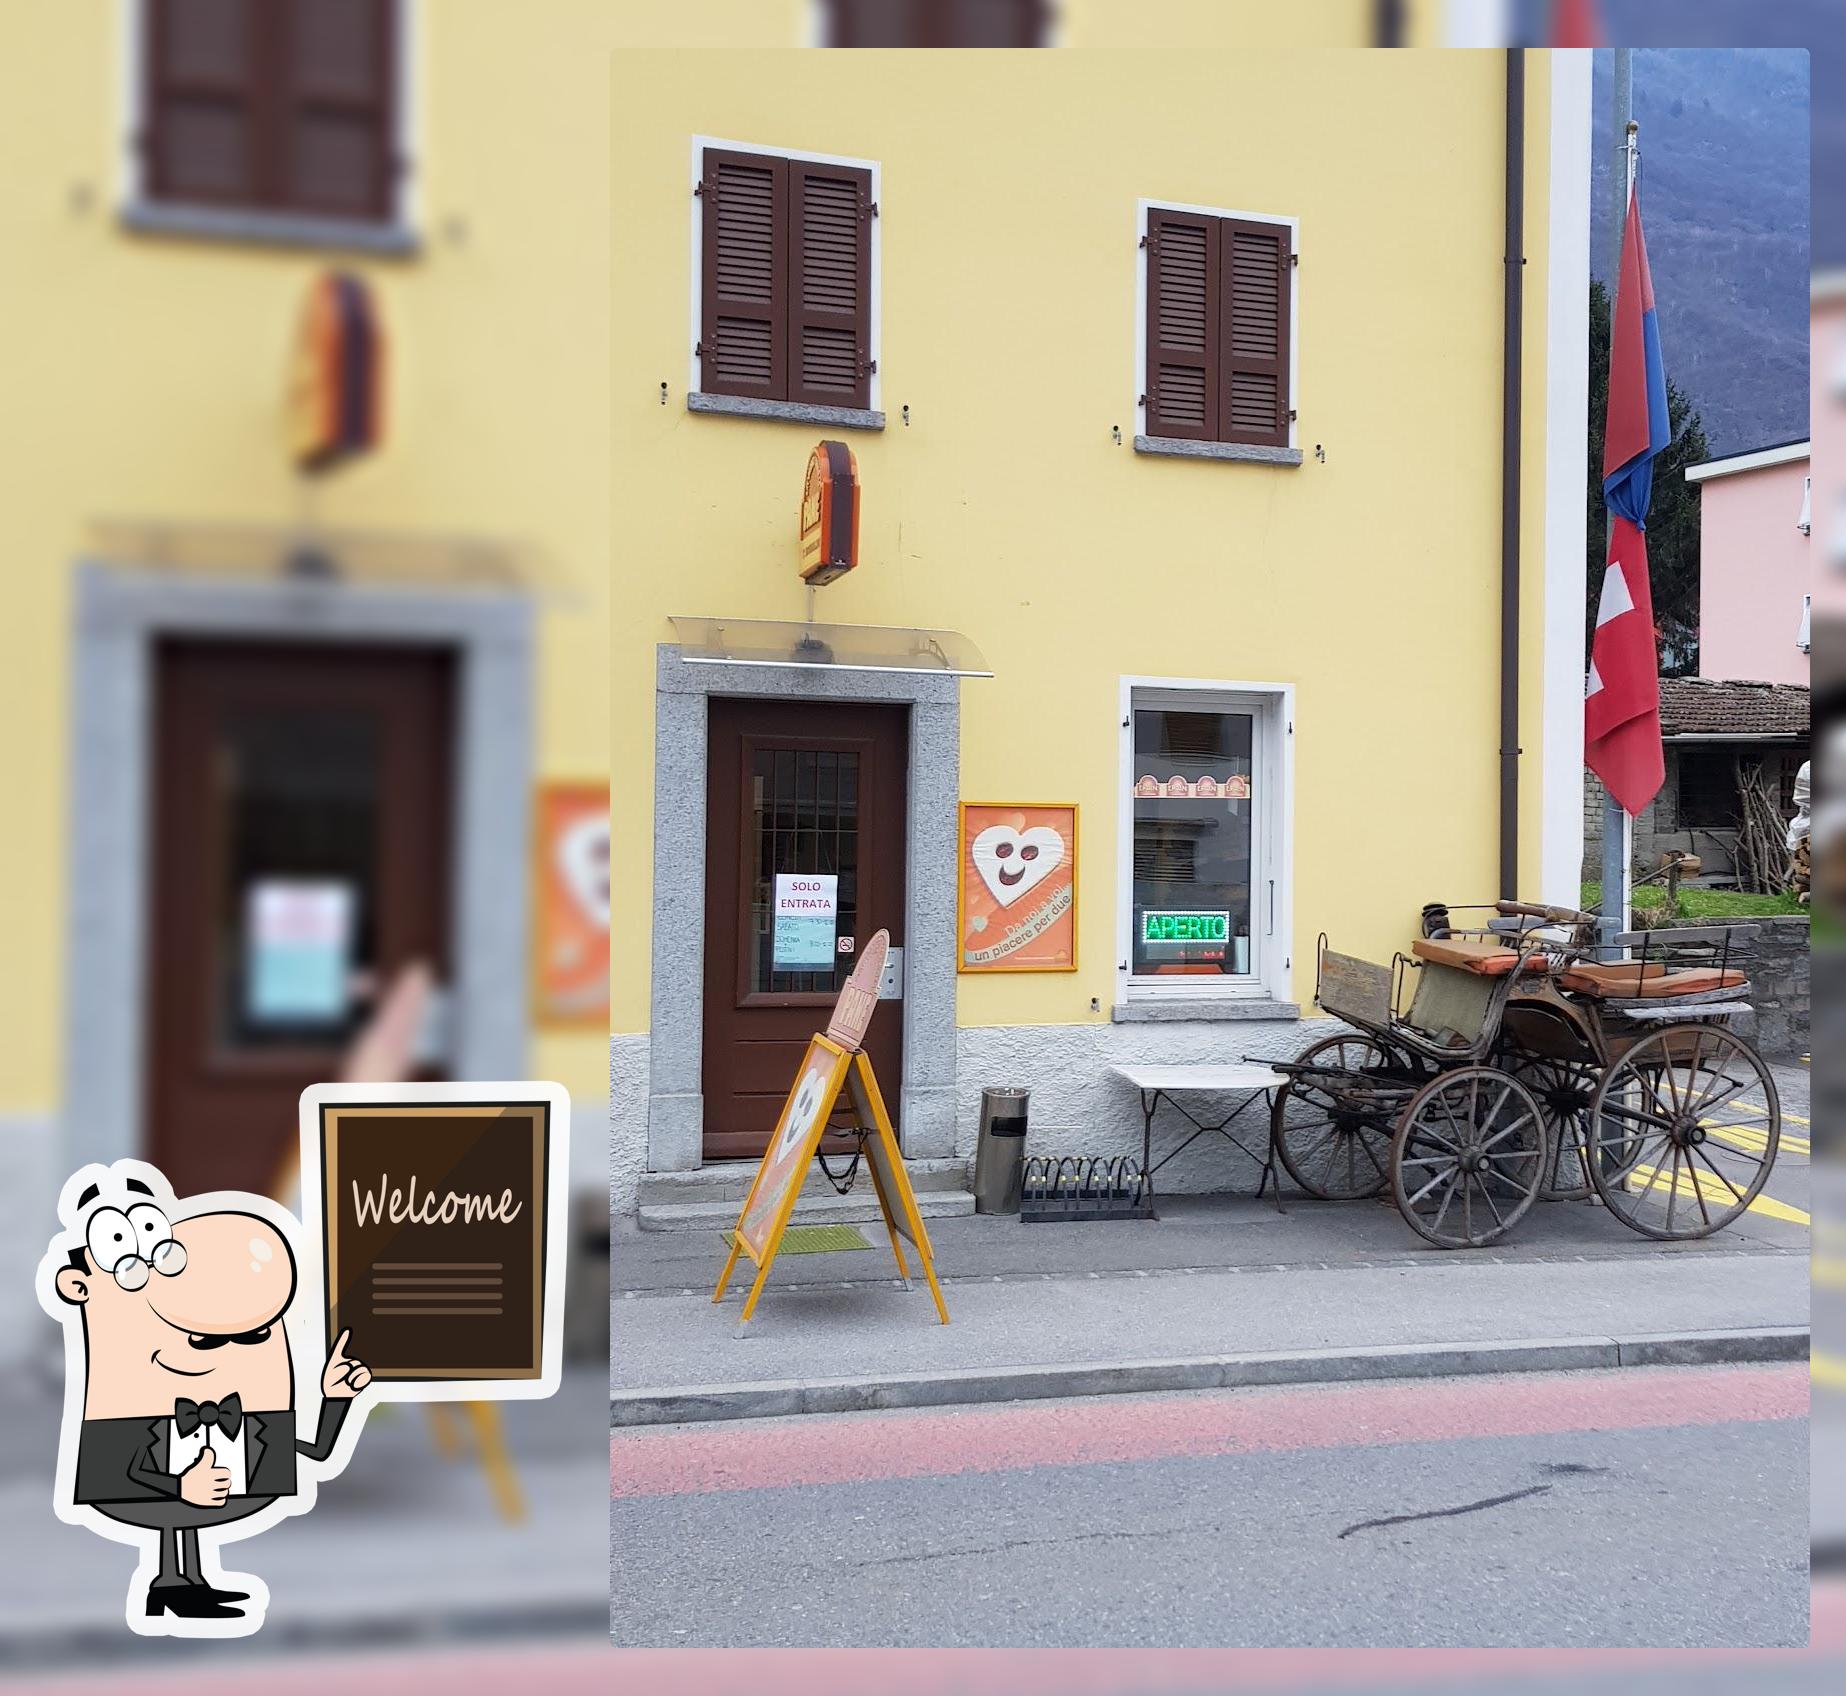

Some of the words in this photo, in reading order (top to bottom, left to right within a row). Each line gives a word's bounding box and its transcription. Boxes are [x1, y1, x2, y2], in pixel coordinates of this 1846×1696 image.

[792, 882, 821, 891] SOLO
[781, 899, 831, 909] ENTRATA
[974, 950, 990, 961] un
[994, 929, 1033, 960] piacere
[1033, 913, 1052, 933] per
[1051, 895, 1071, 915] due
[1146, 916, 1227, 939] APERTO
